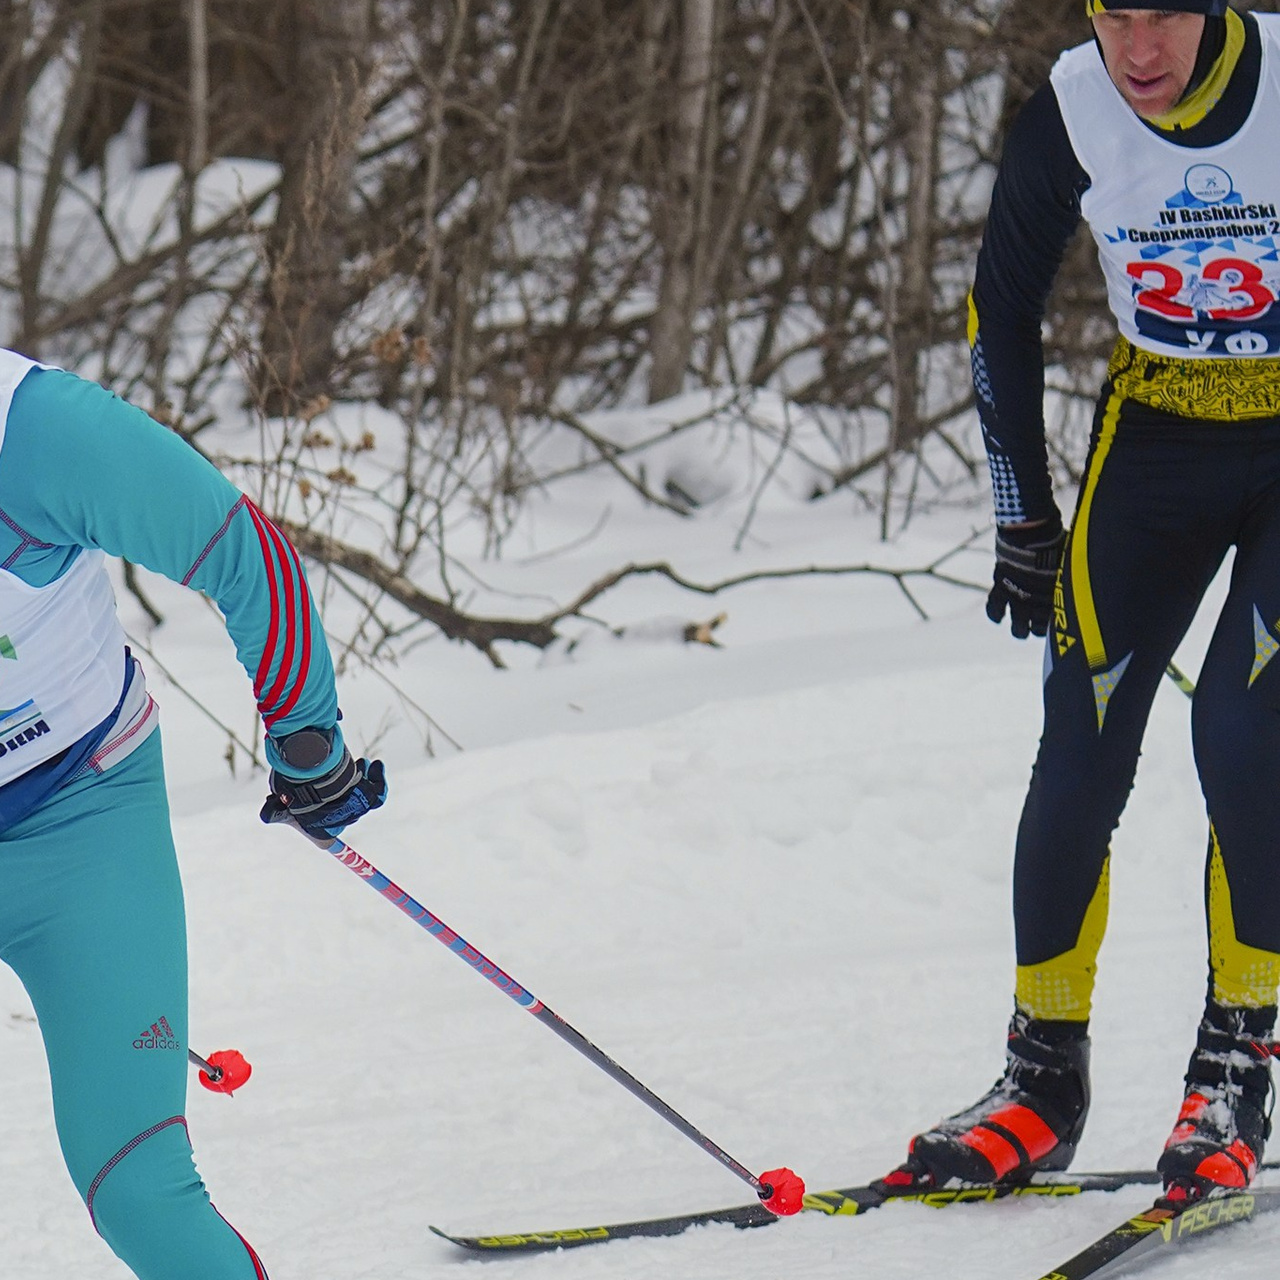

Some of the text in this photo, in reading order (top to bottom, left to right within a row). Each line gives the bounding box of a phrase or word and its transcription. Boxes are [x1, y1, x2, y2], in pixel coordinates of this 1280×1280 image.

[1159, 203, 1277, 226] IV BashkirSki
[1127, 222, 1268, 244] Сверхмарафон
[132, 1035, 181, 1051] adidas
